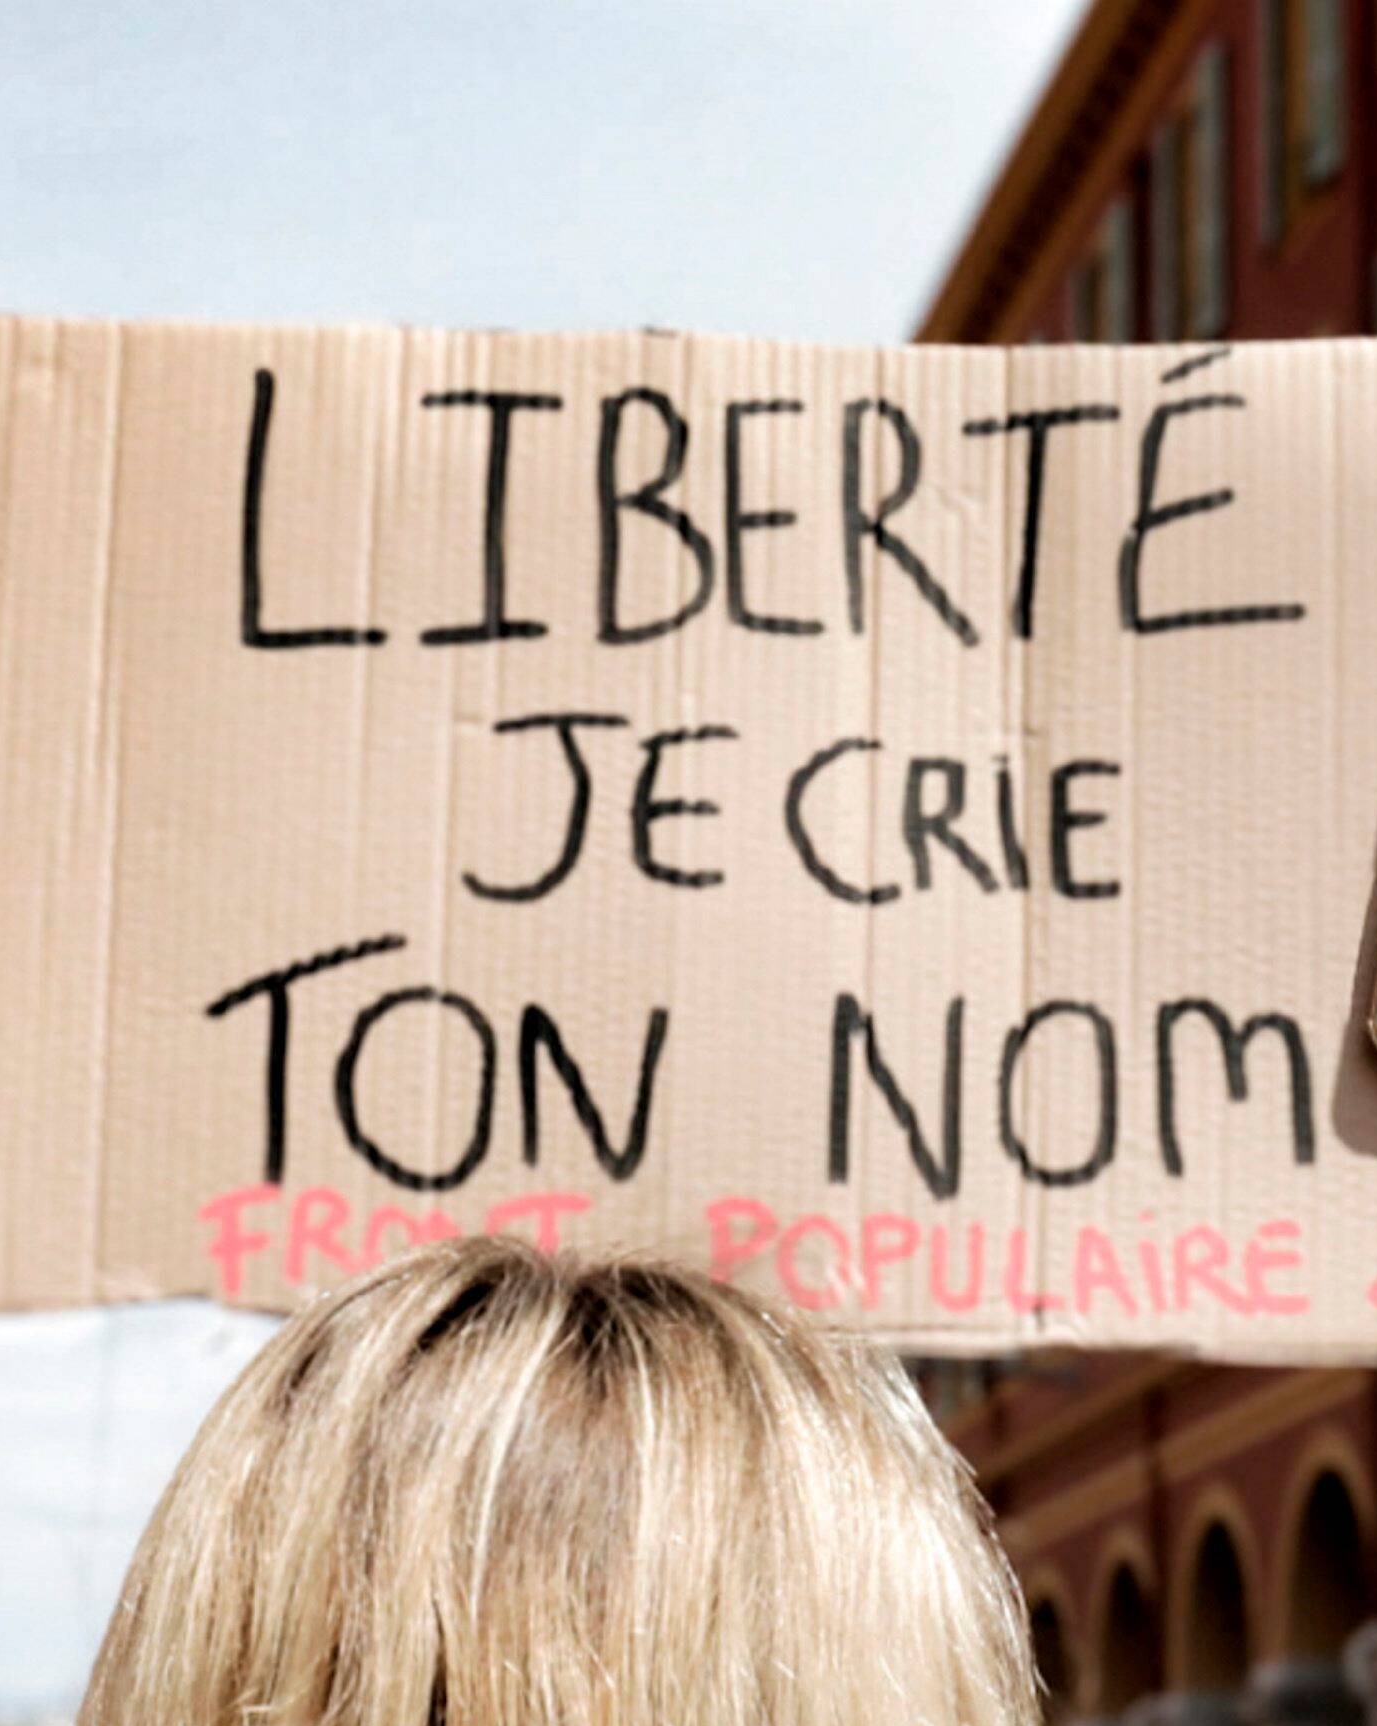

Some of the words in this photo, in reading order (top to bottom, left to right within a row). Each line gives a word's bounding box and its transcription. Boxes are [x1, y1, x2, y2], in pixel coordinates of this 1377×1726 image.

[240, 350, 1306, 650] LIBERTÉ
[461, 711, 739, 903] JE
[205, 934, 670, 1194] TON
